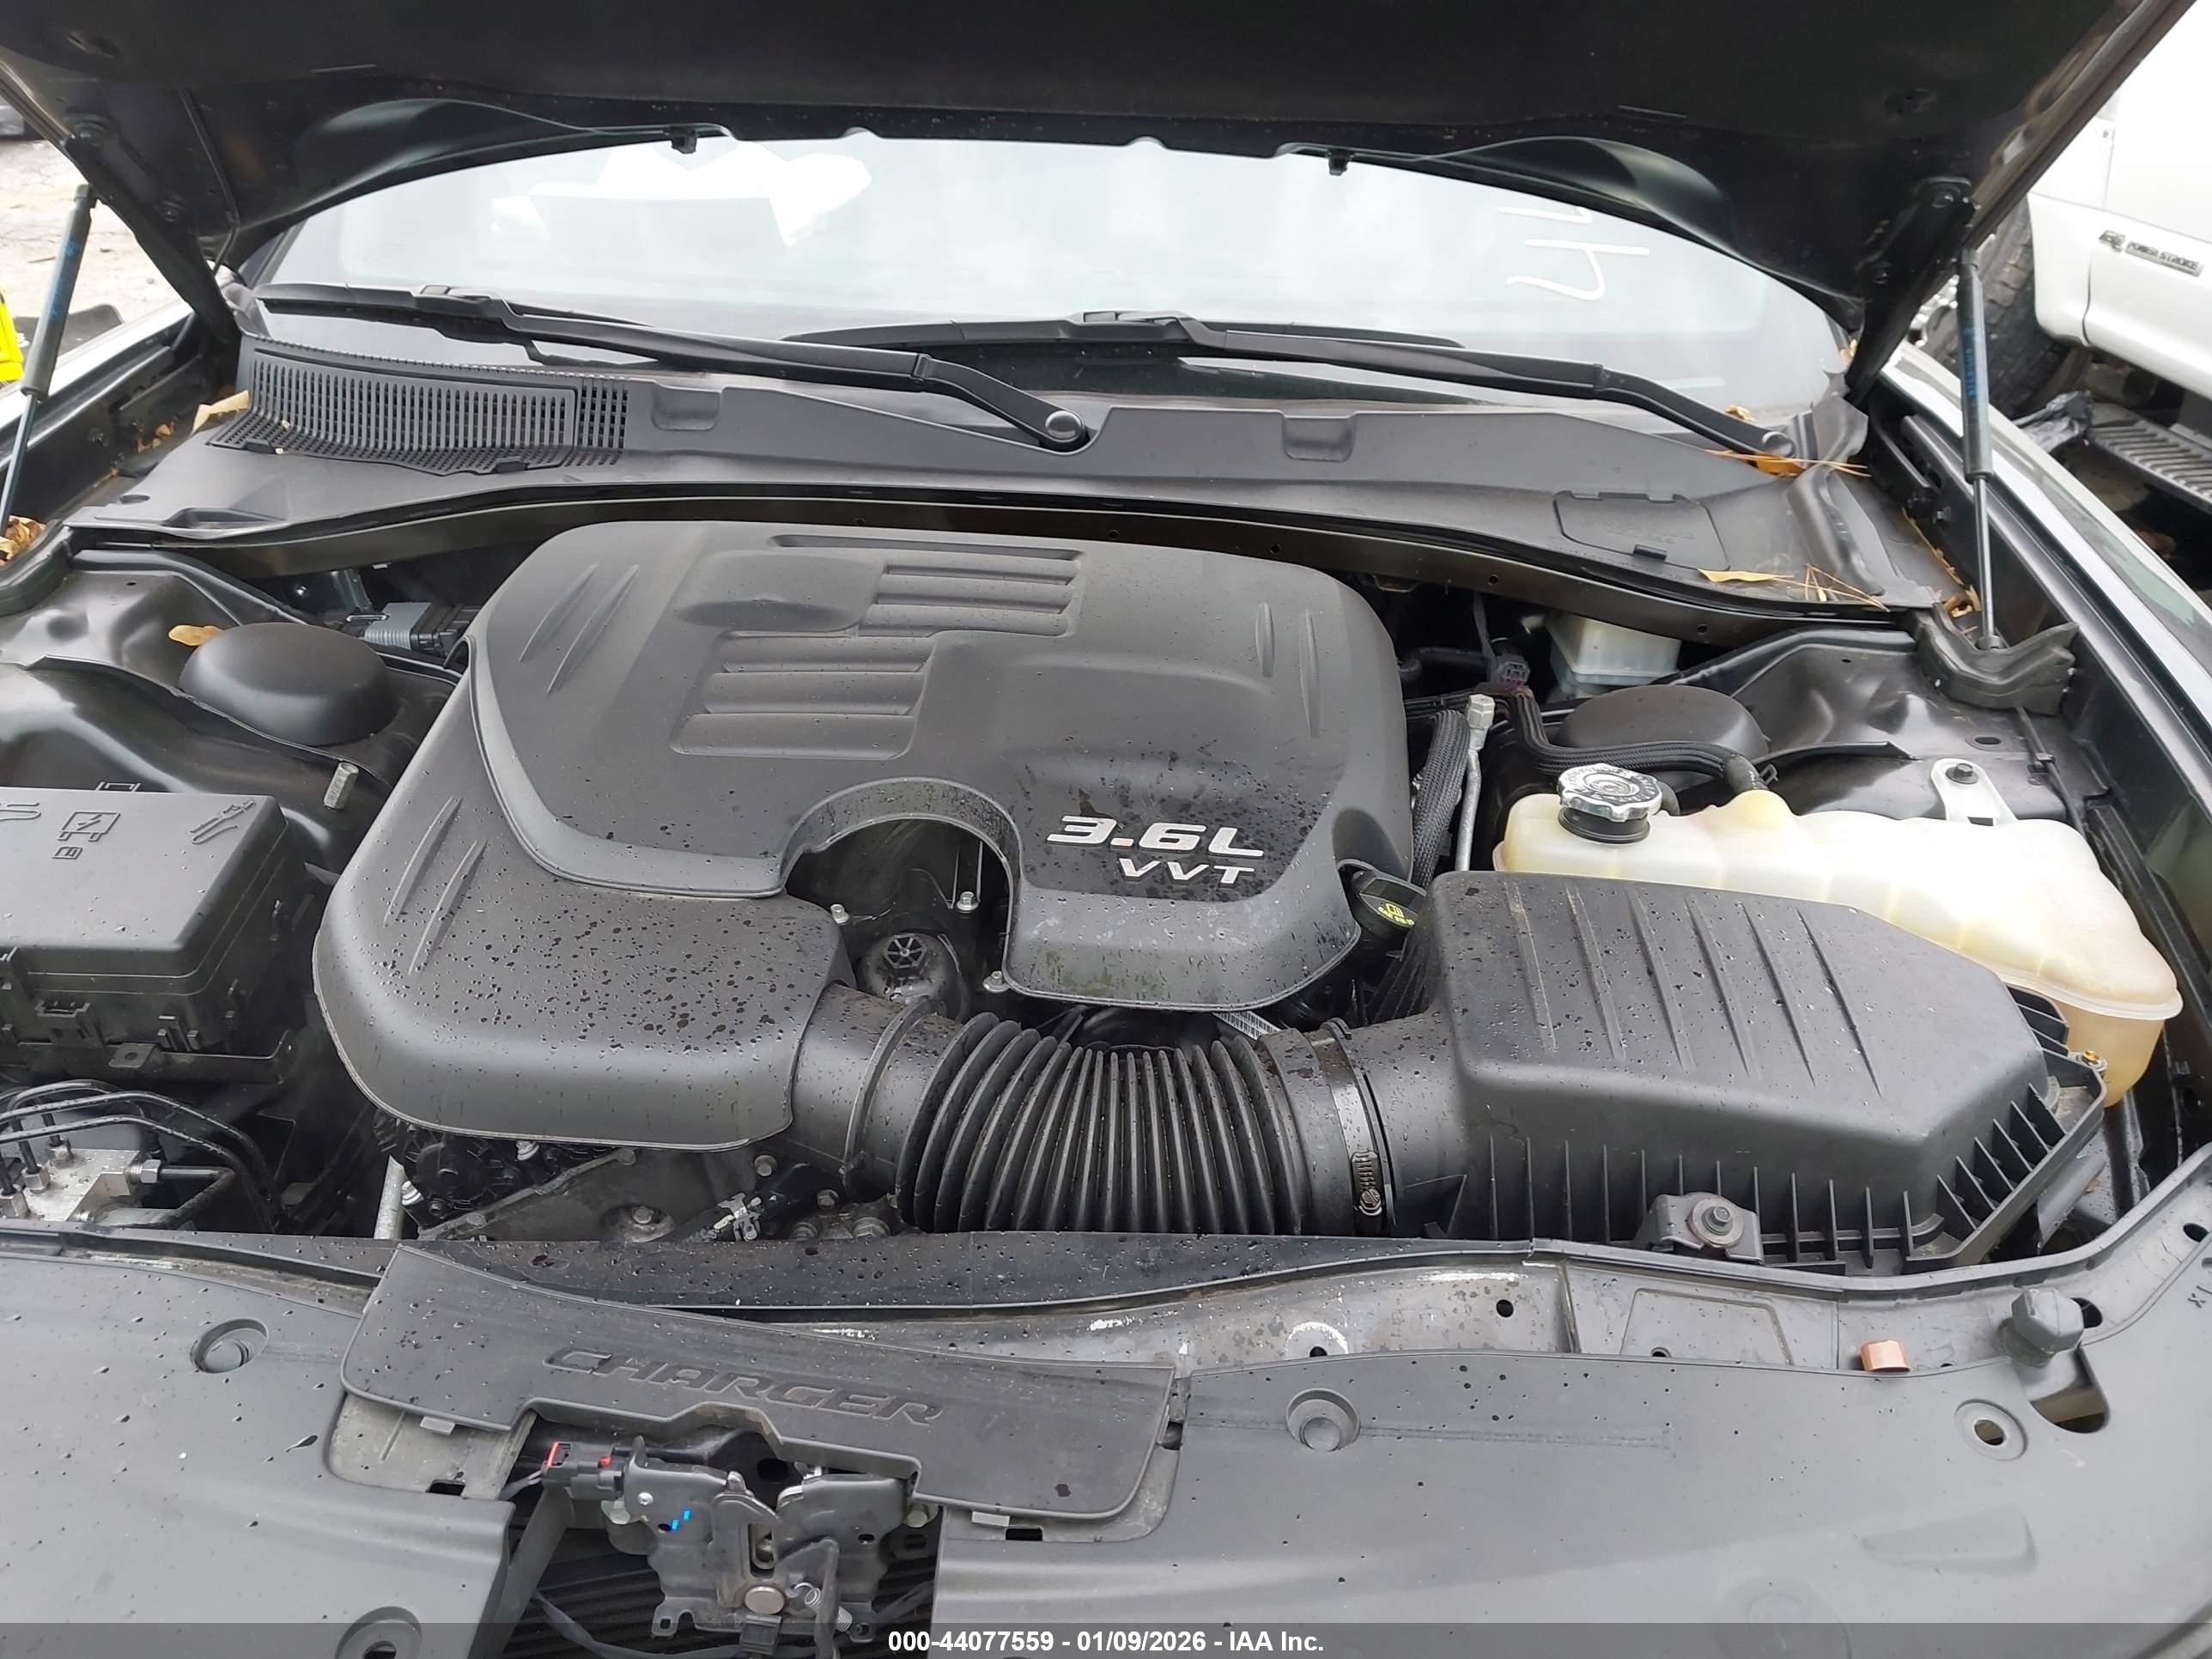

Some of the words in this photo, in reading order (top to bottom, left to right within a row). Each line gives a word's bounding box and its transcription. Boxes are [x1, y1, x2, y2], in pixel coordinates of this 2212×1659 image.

[1046, 815, 1265, 858] 3.6L
[1118, 858, 1255, 886] VVT
[542, 1346, 944, 1427] CHARGER
